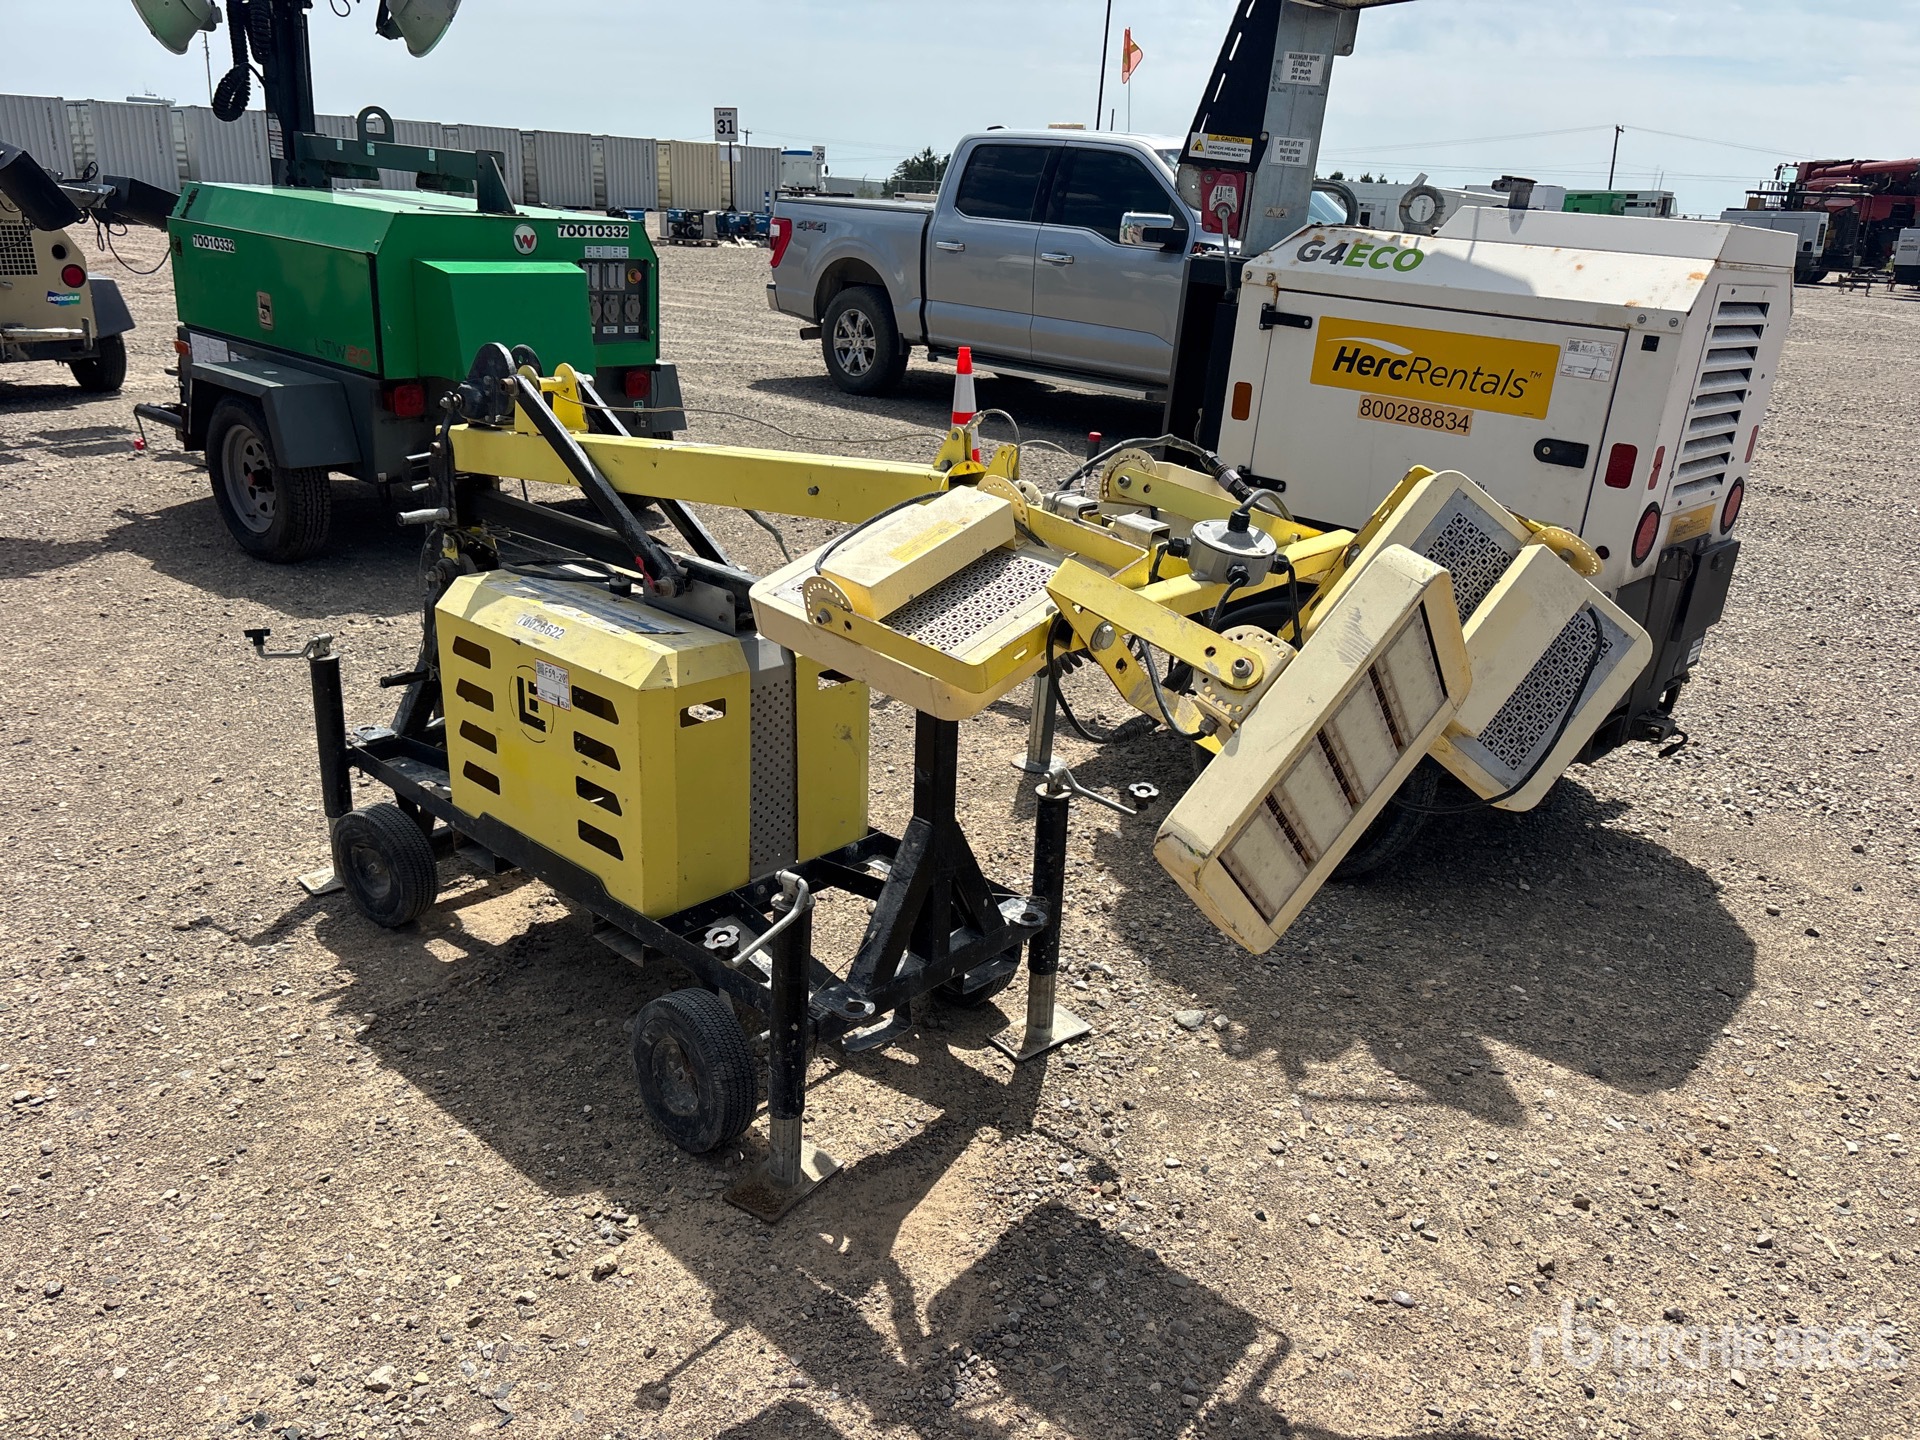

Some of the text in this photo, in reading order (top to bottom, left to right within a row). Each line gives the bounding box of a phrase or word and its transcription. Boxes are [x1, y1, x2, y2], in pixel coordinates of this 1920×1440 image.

[1293, 60, 1313, 68] STABILITY
[717, 119, 735, 134] 31
[816, 152, 824, 160] 29
[559, 224, 629, 238] 70010332
[193, 234, 236, 252] 70010332
[1296, 240, 1425, 272] G4ECO
[1332, 346, 1529, 399] HercRentals
[1360, 398, 1470, 433] 800288834
[518, 613, 566, 640] 70026622
